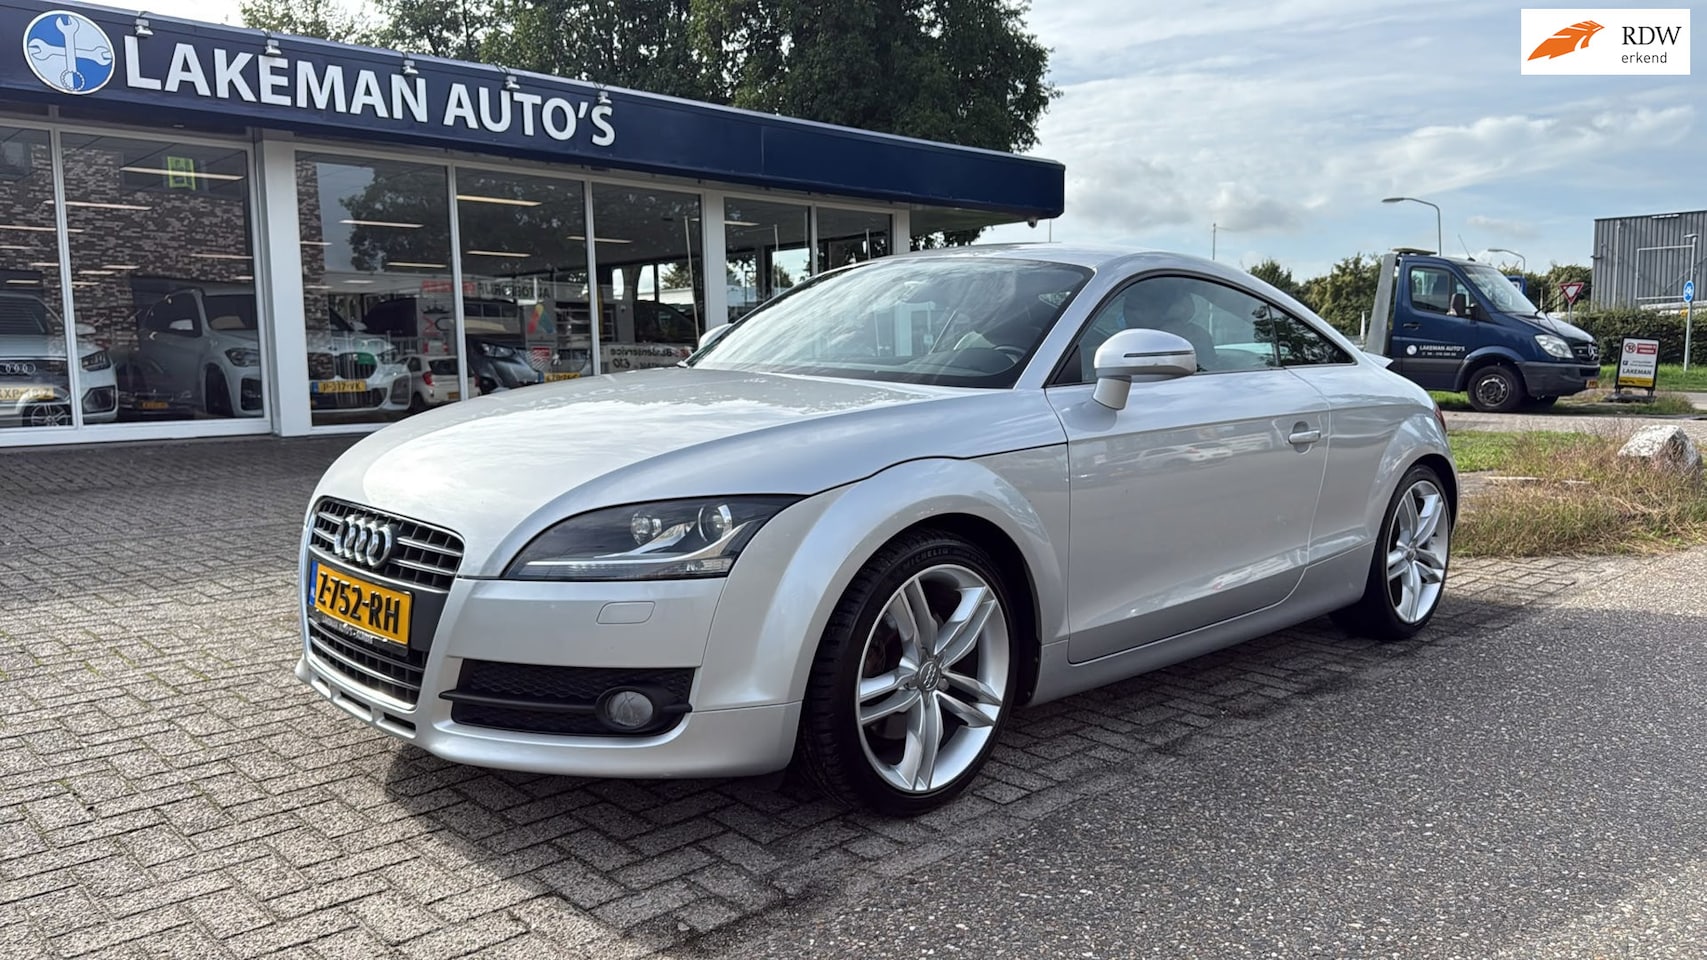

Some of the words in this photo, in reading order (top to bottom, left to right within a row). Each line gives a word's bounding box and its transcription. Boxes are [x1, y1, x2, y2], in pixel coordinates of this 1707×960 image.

[123, 34, 429, 123] LAKEMAN
[442, 82, 616, 147] AUTO'S
[1622, 368, 1652, 376] LAKEMAN
[317, 571, 401, 635] Z-752-RH
